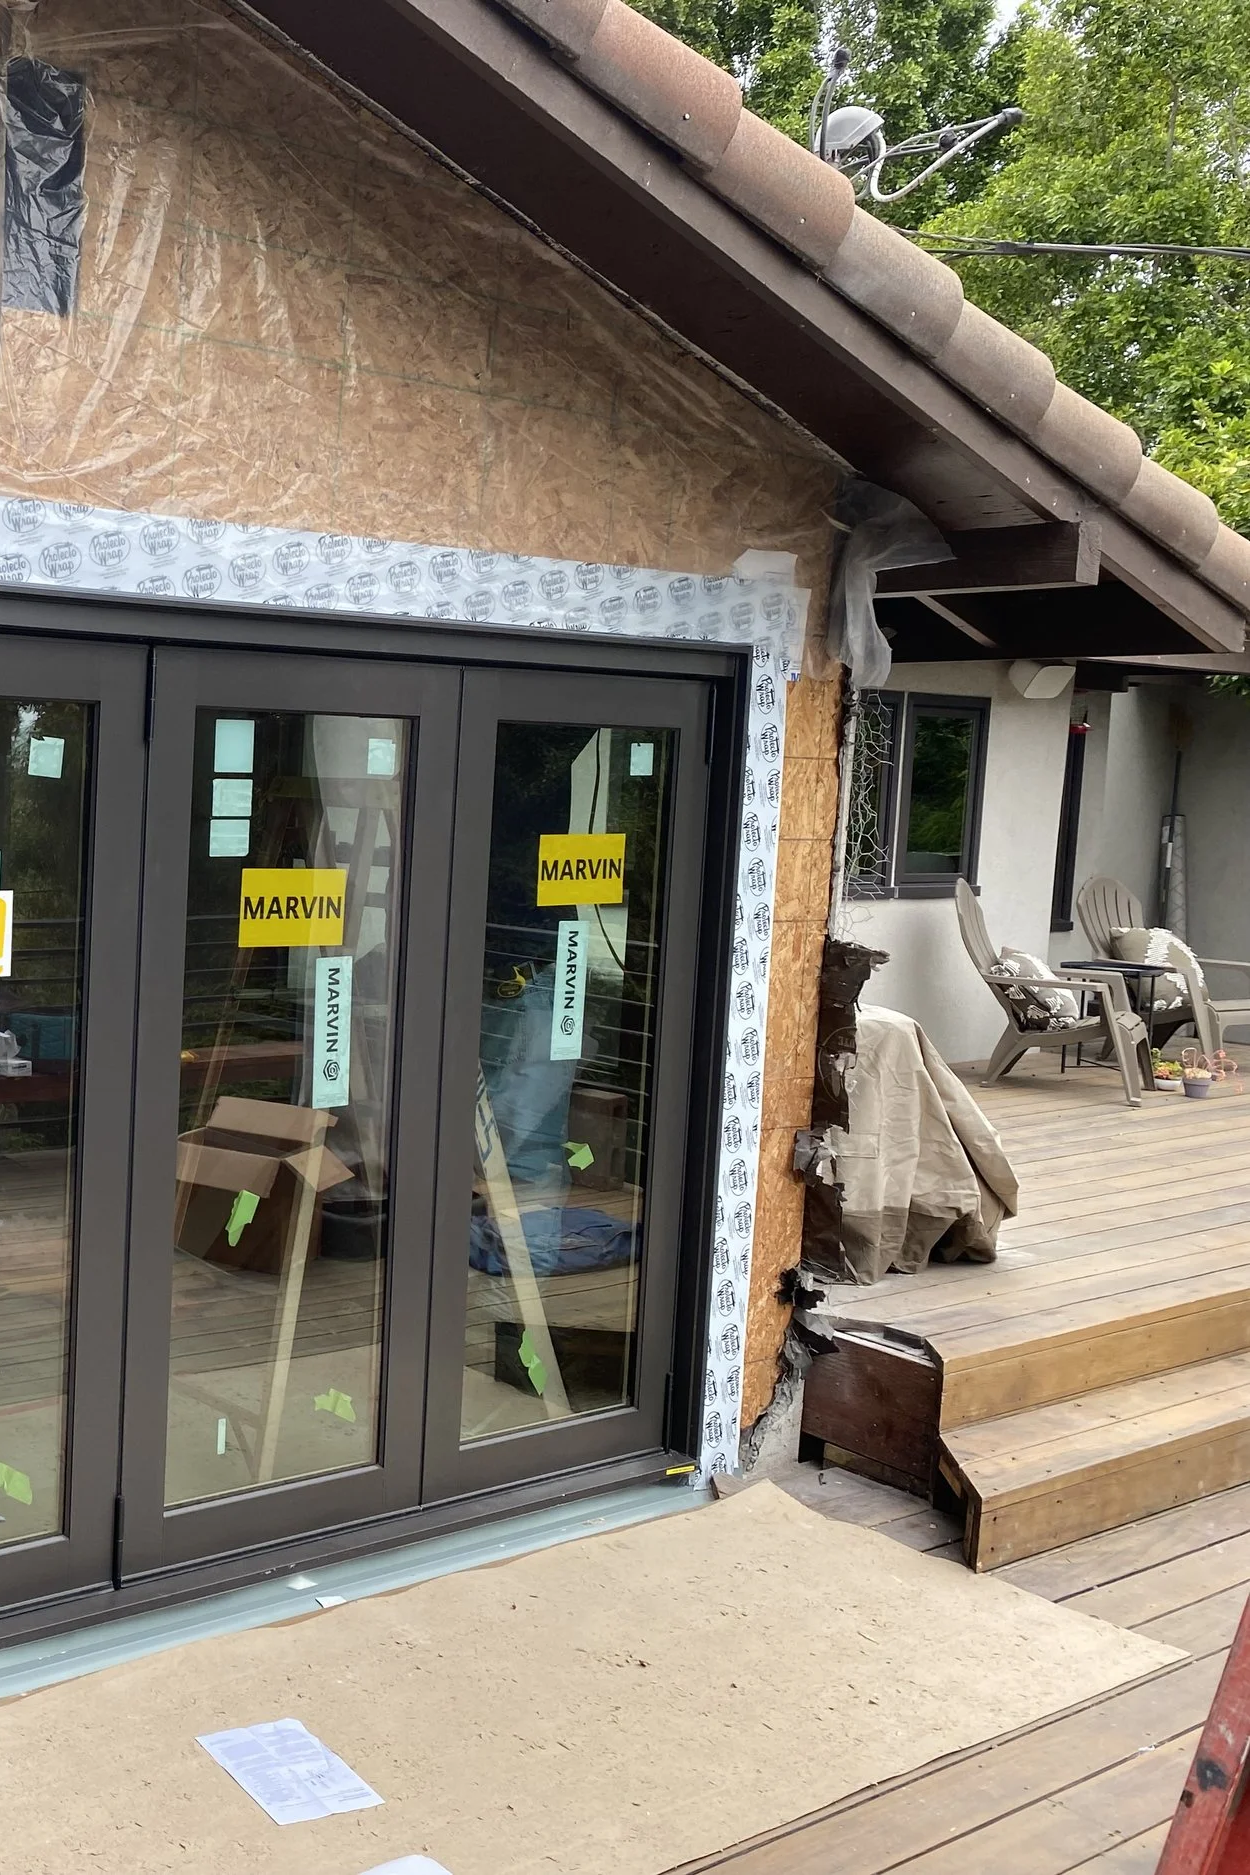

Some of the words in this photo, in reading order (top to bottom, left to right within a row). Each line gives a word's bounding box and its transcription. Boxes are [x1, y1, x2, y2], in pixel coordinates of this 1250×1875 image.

[5, 498, 40, 523] Protecto
[12, 515, 38, 533] Wrap
[142, 521, 174, 546] Protecto
[92, 532, 125, 557] Protecto
[148, 539, 172, 555] Wrap
[195, 529, 219, 544] Wrap
[318, 533, 347, 556] Protecto
[41, 543, 76, 569] Protecto
[98, 549, 123, 566] Wrap
[231, 554, 261, 578] Protecto
[275, 542, 305, 567] Protecto
[324, 549, 345, 564] Wrap
[48, 561, 74, 578] Wrap
[185, 566, 217, 590] Protecto
[237, 571, 259, 587] Wrap
[281, 559, 303, 576] Wrap
[191, 582, 215, 599] Wrap
[756, 684, 765, 707] Wrap
[762, 676, 775, 709] Protecto
[761, 732, 769, 756] Wrap
[765, 725, 779, 758] Protecto
[767, 778, 775, 801] Wrap
[743, 822, 751, 844] Wrap
[748, 813, 760, 846] Protecto
[541, 858, 622, 881] MARVIN
[748, 868, 757, 890] Wrap
[752, 859, 766, 892] Protecto
[244, 896, 342, 919] MARVIN
[754, 912, 762, 935] Wrap
[759, 904, 770, 936] Protecto
[735, 938, 748, 971] Protecto
[564, 930, 579, 1009] MARVIN
[326, 967, 340, 1052] MARVIN
[736, 991, 745, 1013] Wrap
[741, 983, 755, 1015] Protecto
[741, 1037, 750, 1060] Wrap
[746, 1029, 759, 1061] Protecto
[747, 1081, 755, 1103] Wrap
[724, 1125, 732, 1147] Wrap
[728, 1116, 742, 1149] Protecto
[734, 1160, 747, 1192] Protecto
[717, 1237, 729, 1270] Protecto
[722, 1280, 735, 1312] Protecto
[726, 1324, 740, 1356] Protecto
[727, 1375, 735, 1397] Wrap
